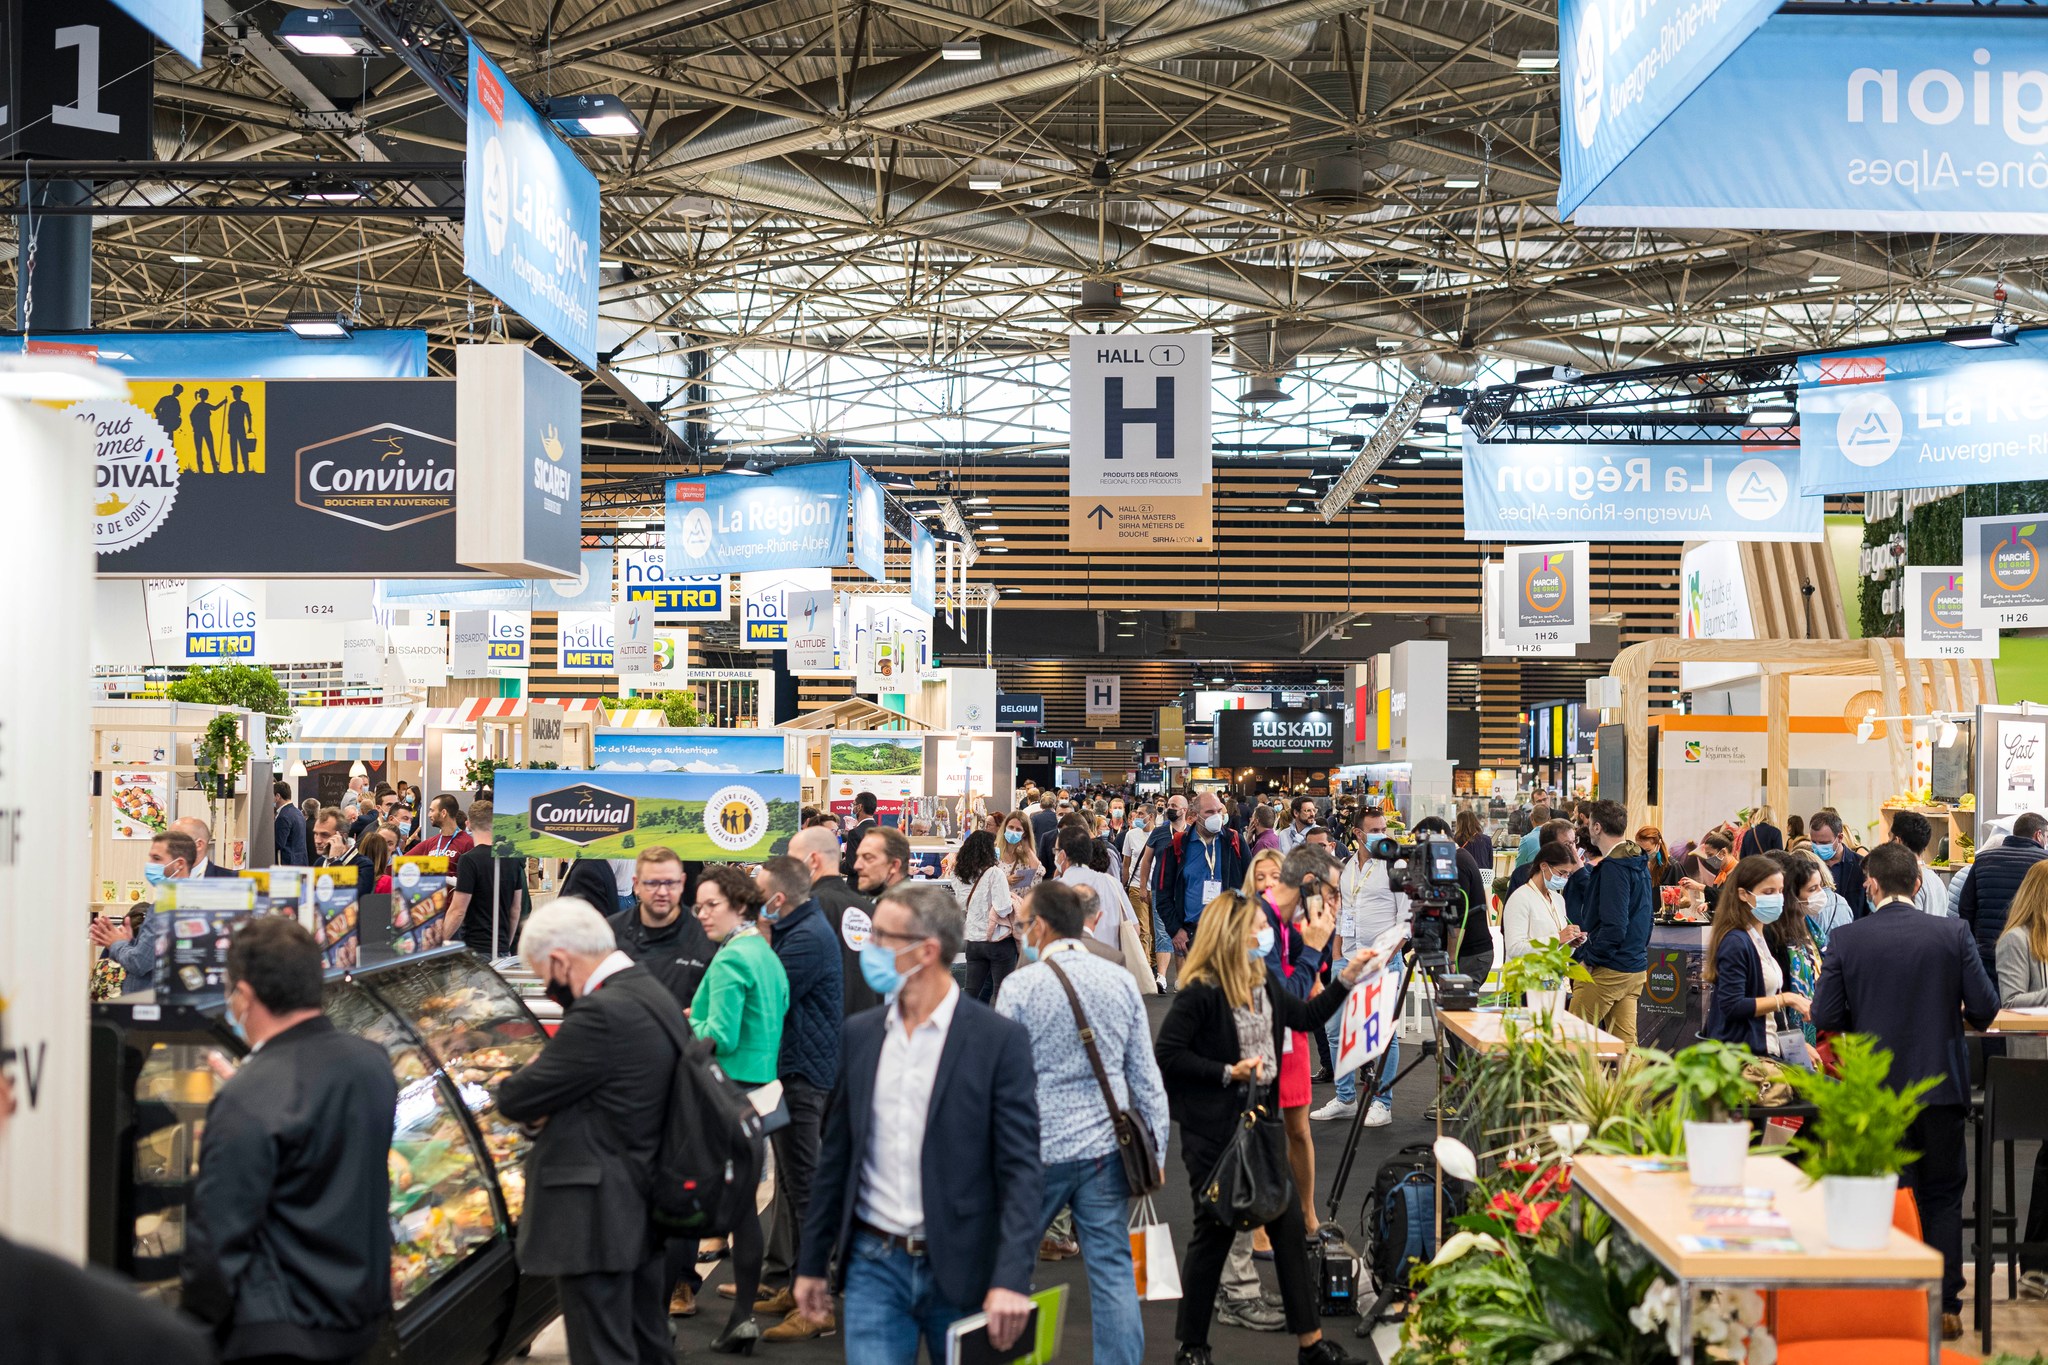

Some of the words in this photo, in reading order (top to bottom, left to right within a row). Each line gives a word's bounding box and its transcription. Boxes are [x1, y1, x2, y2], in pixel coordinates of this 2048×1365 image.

[1608, 0, 1722, 124] Auvergne-Rhône-Alp
[52, 25, 120, 134] 1
[1097, 349, 1144, 363] HALL
[1163, 349, 1170, 362] 1
[1918, 388, 1971, 429] La
[1104, 376, 1175, 459] H
[94, 435, 146, 456] mmes
[1918, 434, 2048, 464] Auvergne-R
[95, 464, 175, 488] DIVAL
[309, 459, 456, 492] Convivia
[534, 457, 571, 502] SICAREV
[1150, 470, 1179, 478] RÉGIONS
[324, 499, 374, 507] BOUCHER
[377, 499, 390, 507] EN
[393, 499, 450, 507] AUVERGNE
[108, 522, 123, 535] DE
[125, 500, 151, 527] GOÛT
[718, 505, 743, 534] La
[749, 496, 831, 536] Région
[1142, 521, 1173, 529] MÉTIERS
[718, 535, 830, 559] Auvergne-Rhône-Alpes
[644, 551, 664, 563] les
[1999, 551, 2030, 562] MARCHÉ
[1533, 577, 1559, 586] MARCHÉ
[632, 590, 717, 607] METRO
[746, 589, 787, 618] hal
[761, 592, 777, 603] les
[1938, 597, 1963, 605] MARCH
[200, 600, 215, 611] les
[311, 605, 319, 614] G
[321, 605, 334, 614] 24
[186, 596, 256, 630] halles
[2016, 613, 2028, 622] 26
[488, 614, 525, 638] les
[575, 626, 589, 635] les
[750, 624, 788, 639] MET
[563, 623, 614, 648] halle
[1548, 632, 1558, 640] 26
[189, 636, 252, 653] METRO
[488, 643, 520, 657] TRO
[620, 645, 647, 655] ALTITUDE
[794, 638, 826, 649] ALTITUDE
[566, 652, 613, 665] METR
[717, 670, 753, 678] DURABLE
[1094, 685, 1112, 706] H
[1252, 721, 1333, 738] EUSKADI
[594, 744, 607, 754] oix
[608, 744, 620, 754] de
[664, 745, 719, 755] authentique
[1037, 741, 1064, 749] YADER
[1252, 739, 1287, 749] BASQUE
[1287, 739, 1333, 749] COUNTRY
[946, 774, 984, 782] ALTITDE
[536, 803, 631, 824] Convivial
[1652, 973, 1674, 981] MARCHÉ
